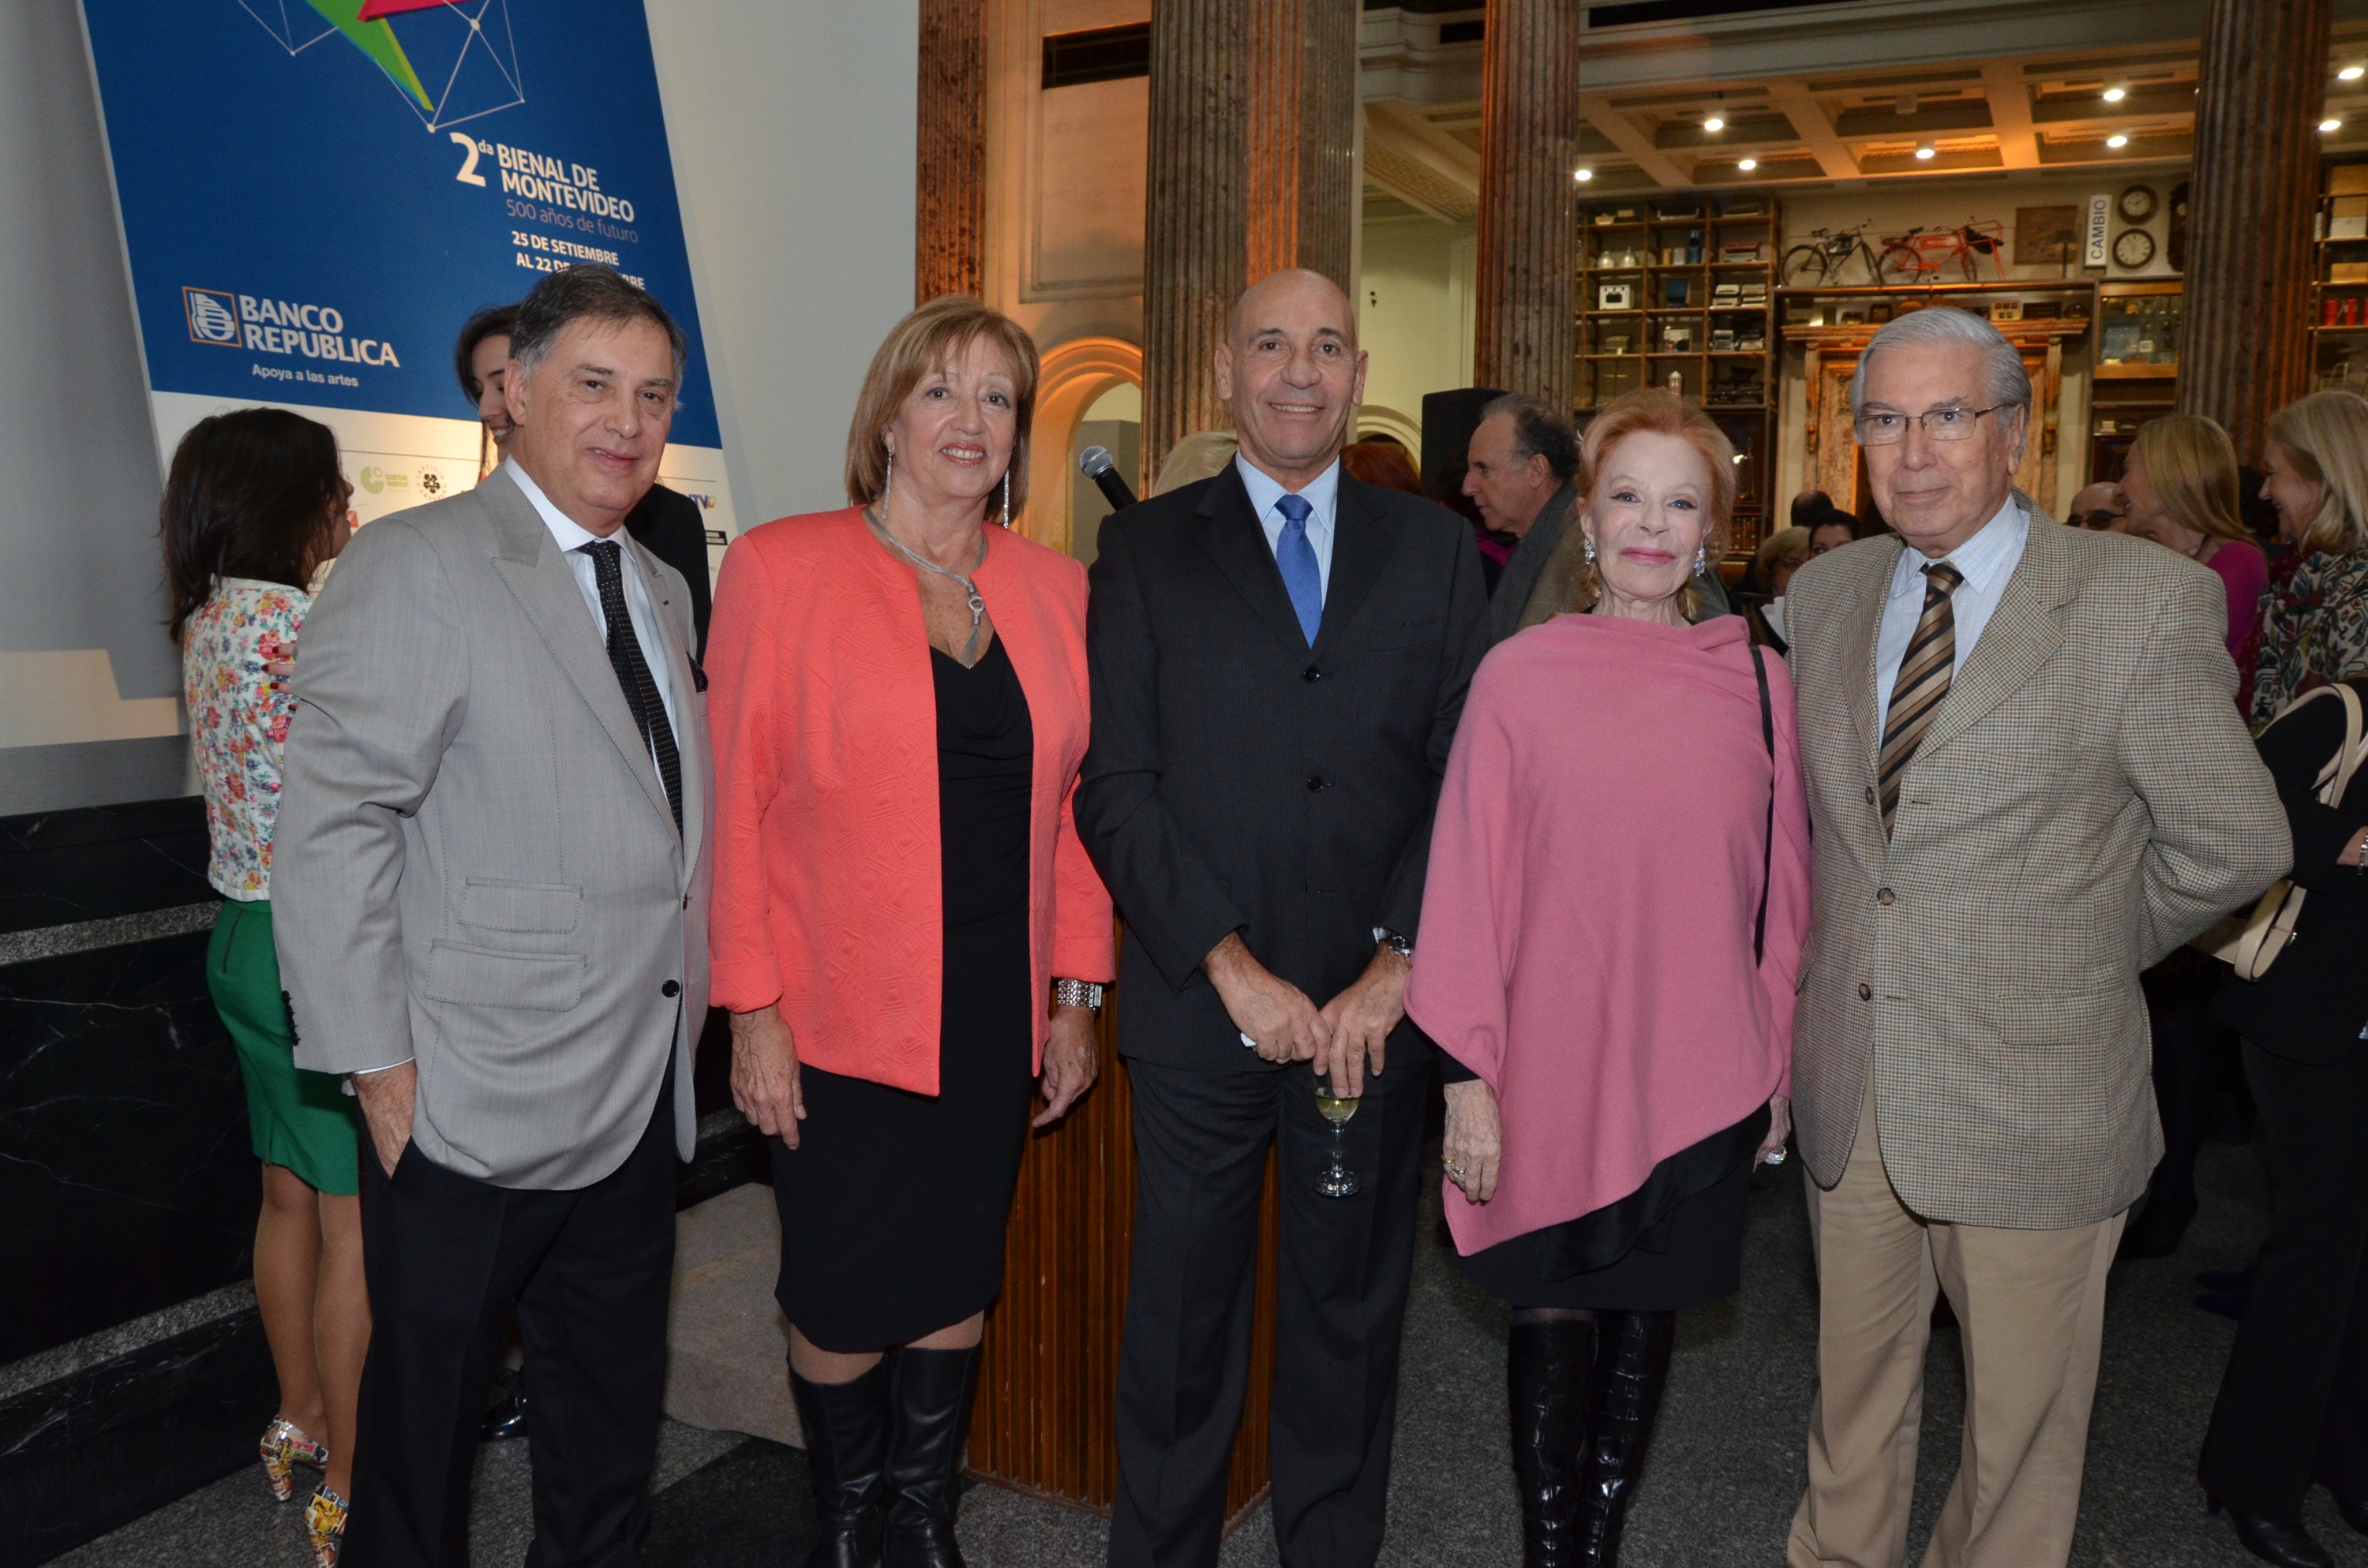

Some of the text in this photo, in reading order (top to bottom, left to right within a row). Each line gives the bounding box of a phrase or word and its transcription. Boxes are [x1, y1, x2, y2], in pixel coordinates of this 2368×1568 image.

[496, 143, 570, 184] BIENAL
[571, 163, 600, 192] DE
[500, 169, 635, 223] MONTEVIDEO
[507, 199, 639, 243] 500 años de futuro
[2091, 200, 2107, 259] CAMBIO
[511, 231, 620, 266] 25 DE SETIEMBRE
[516, 253, 534, 268] AL
[535, 257, 553, 272] 22
[239, 294, 343, 334] BANCO
[244, 323, 400, 368] REPUBLICA
[252, 363, 359, 387] Apoya a las artes
